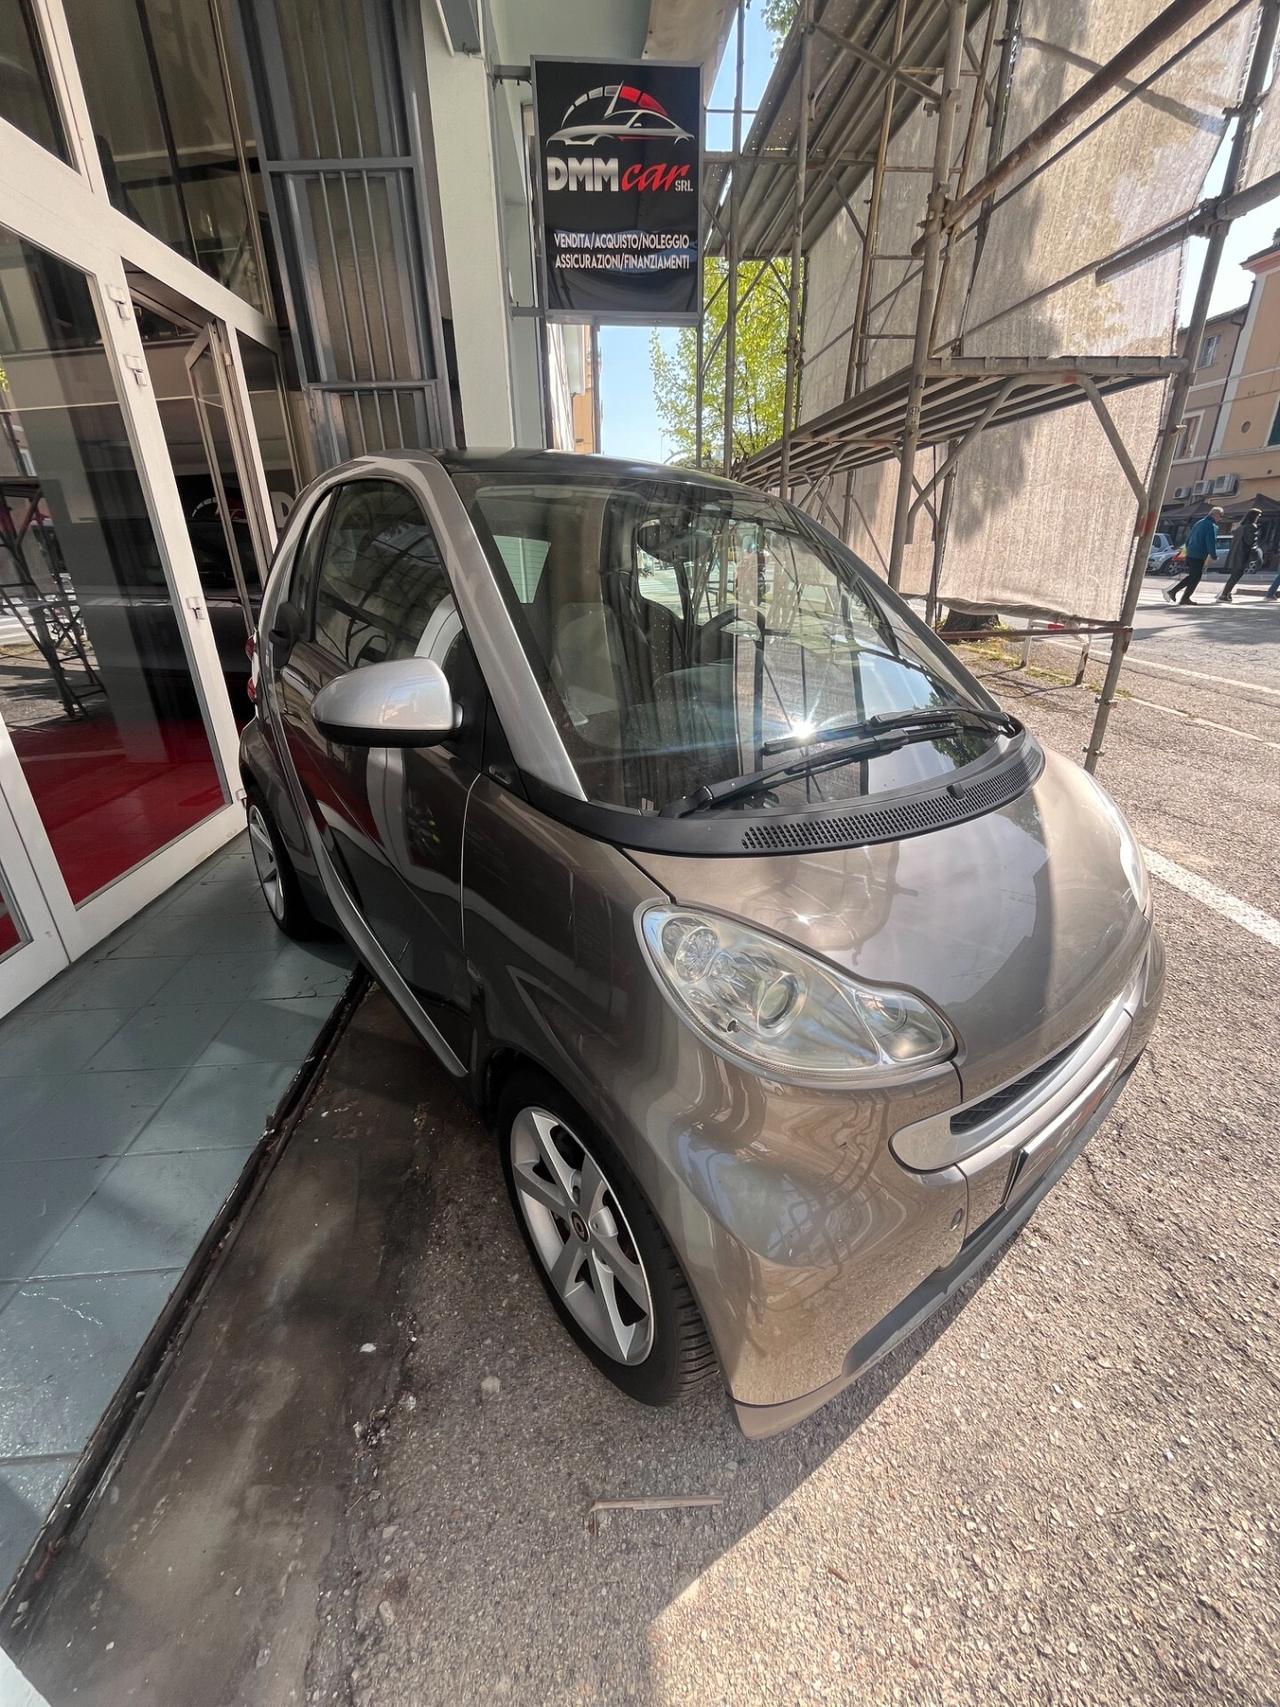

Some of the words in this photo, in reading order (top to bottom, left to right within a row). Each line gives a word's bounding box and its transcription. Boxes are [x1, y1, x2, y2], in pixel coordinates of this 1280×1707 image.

[546, 156, 619, 191] DMM
[621, 163, 690, 192] car
[675, 180, 694, 192] SRL
[553, 232, 690, 250] VENDITA/ACQUISTO/NOLEGGIO
[555, 253, 690, 270] ASSICURAZIONI/FINANZIAMENTI
